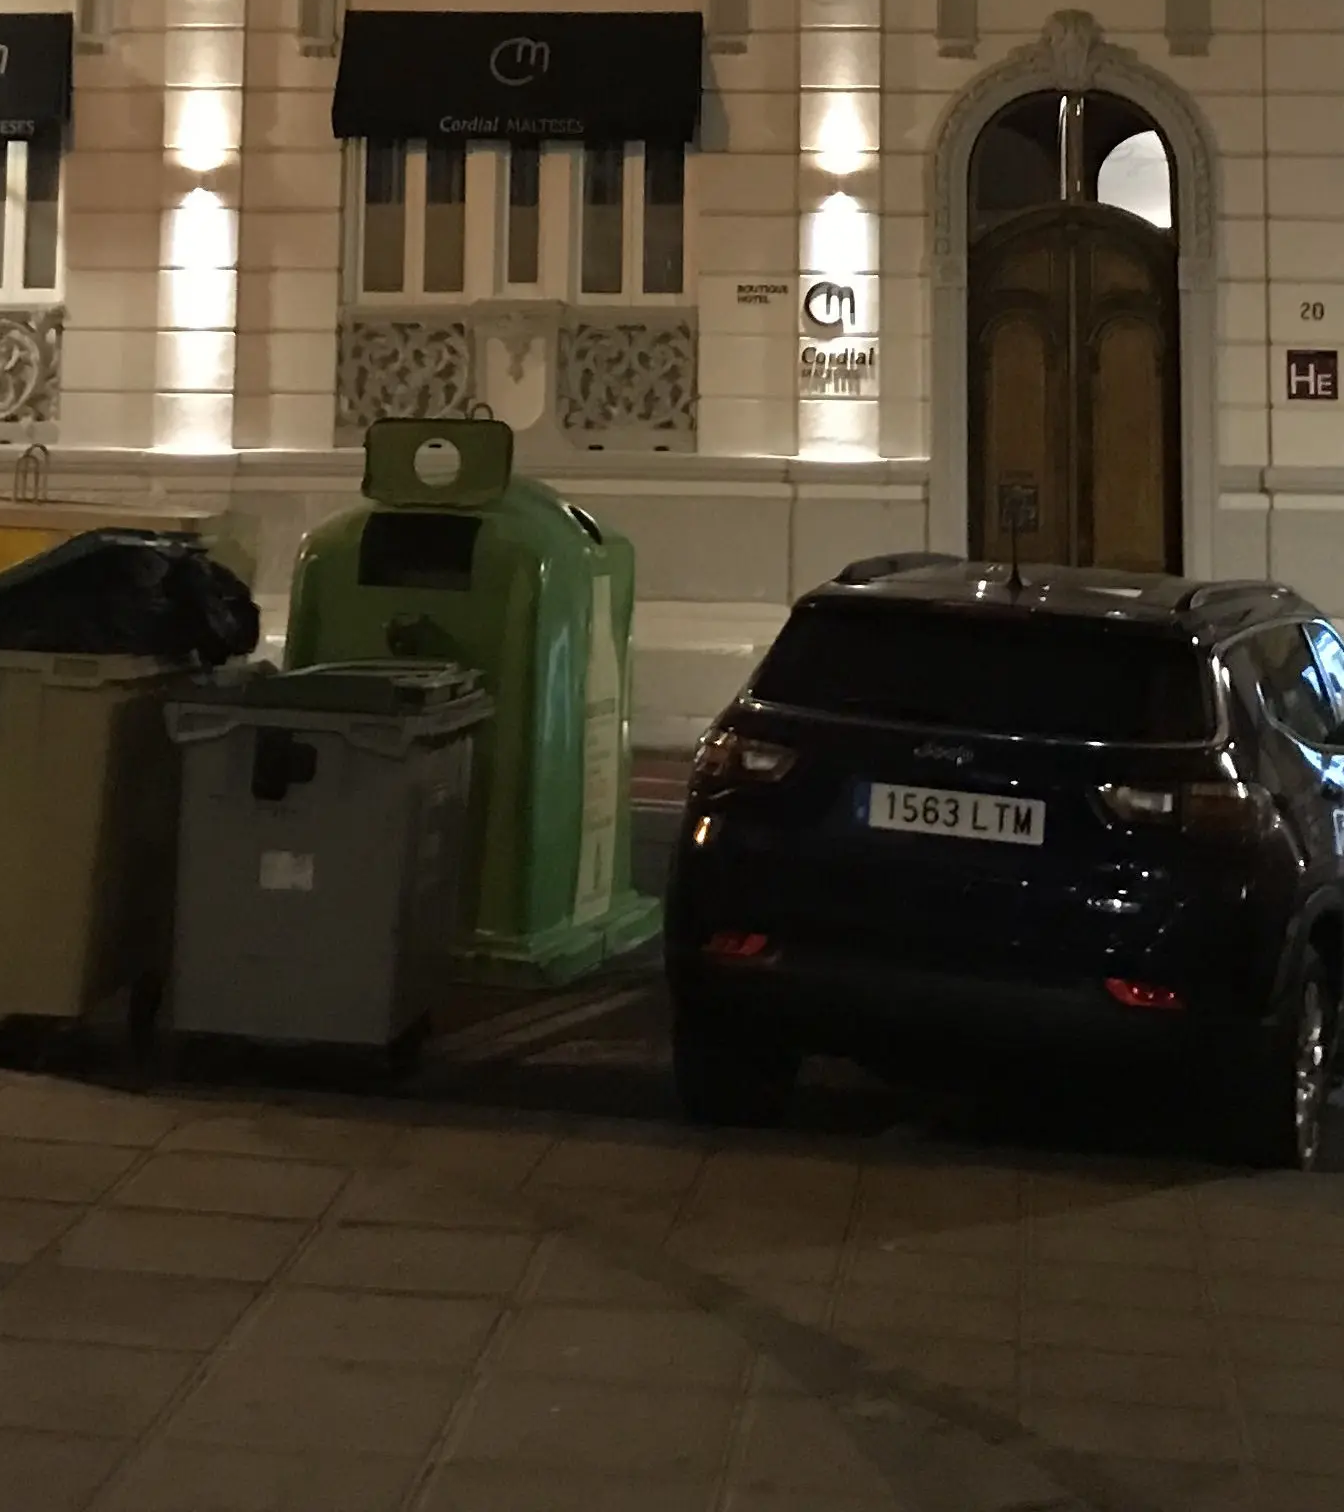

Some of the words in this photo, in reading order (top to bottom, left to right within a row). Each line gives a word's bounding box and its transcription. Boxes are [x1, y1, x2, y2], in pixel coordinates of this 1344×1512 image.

[439, 116, 499, 133] Cordial
[506, 118, 584, 135] MALTESES
[1300, 301, 1325, 321] 20
[802, 346, 875, 365] Cordial
[887, 791, 960, 828] 1563
[971, 800, 1033, 837] LTM
